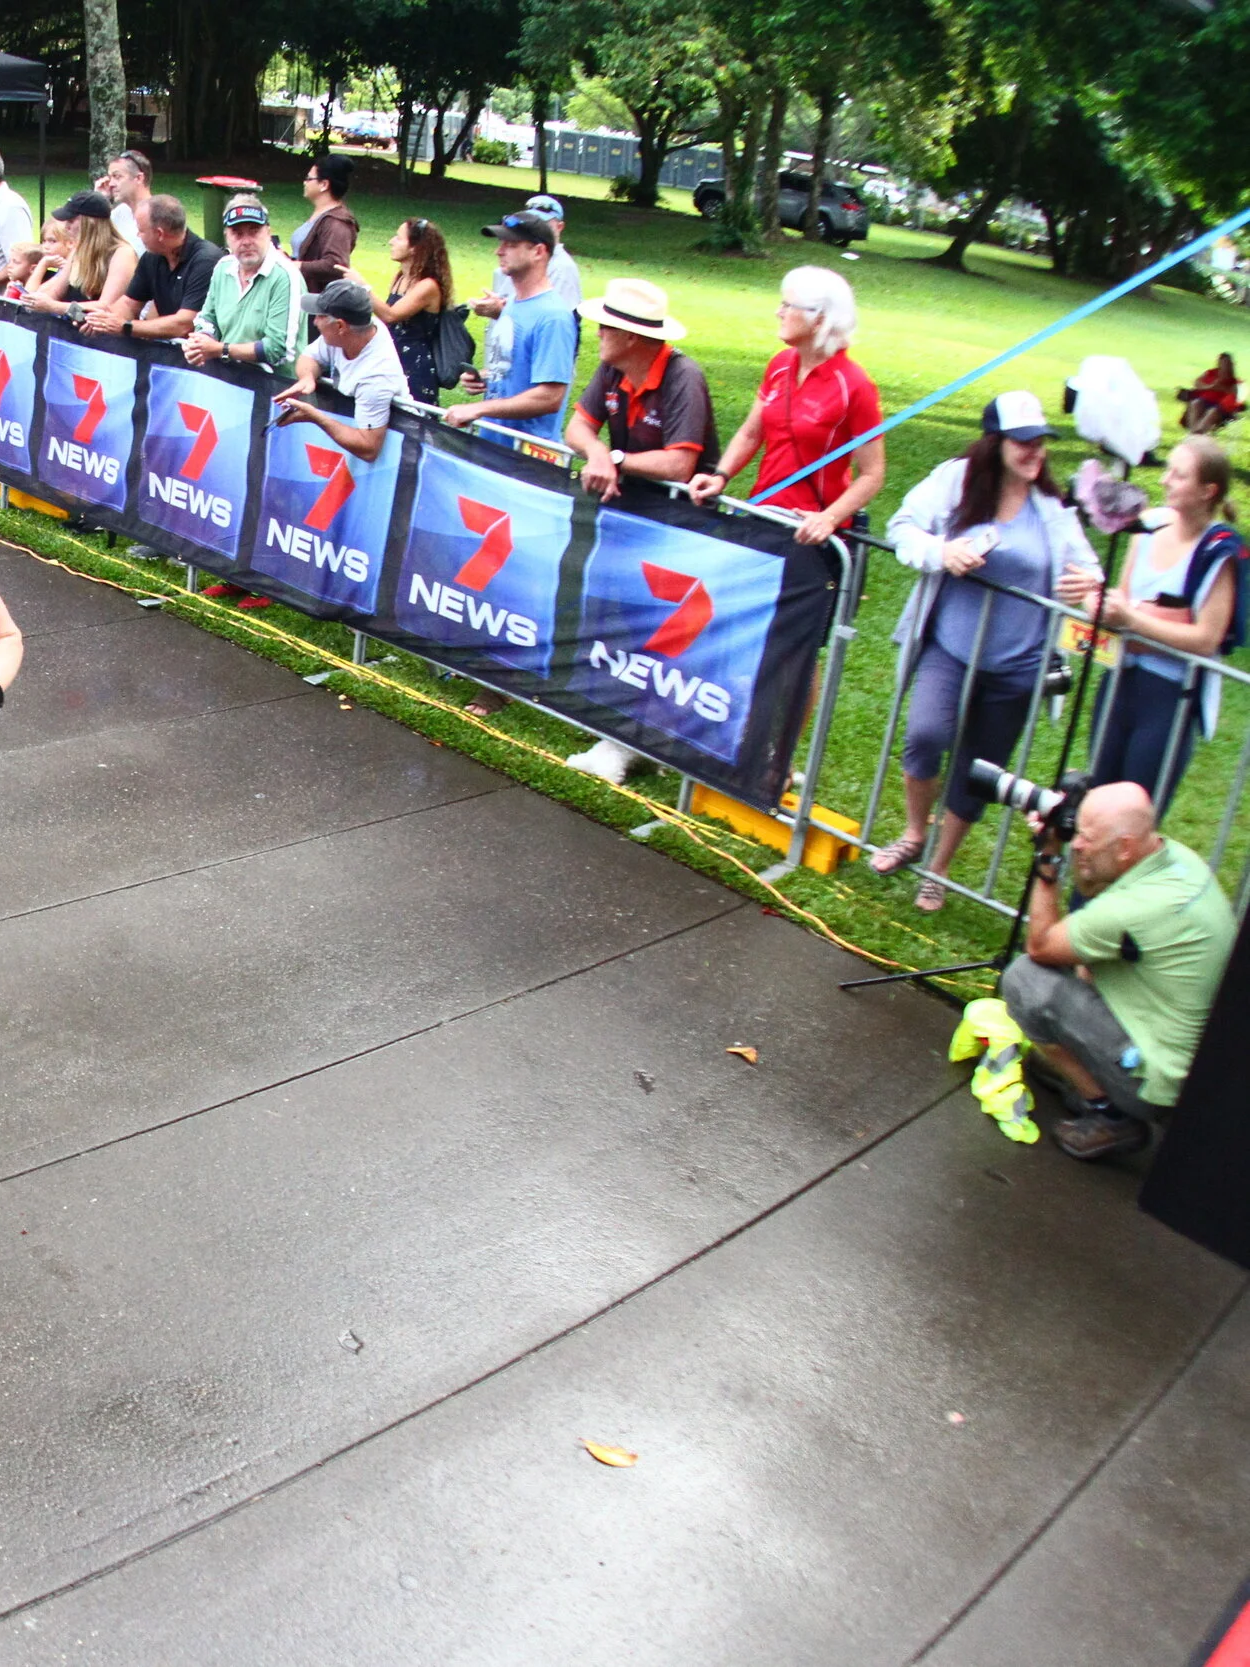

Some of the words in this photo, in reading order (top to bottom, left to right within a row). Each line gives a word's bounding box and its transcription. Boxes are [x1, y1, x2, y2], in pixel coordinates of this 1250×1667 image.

[72, 374, 107, 444] 7
[177, 401, 219, 481] 7
[47, 437, 121, 485] NEWS
[303, 443, 356, 532] 7
[149, 472, 233, 528] NEWS
[266, 518, 369, 583] NEWS
[453, 495, 514, 592] 7
[408, 573, 538, 647] NEWS
[640, 560, 716, 658] 7
[589, 640, 731, 722] NEWS
